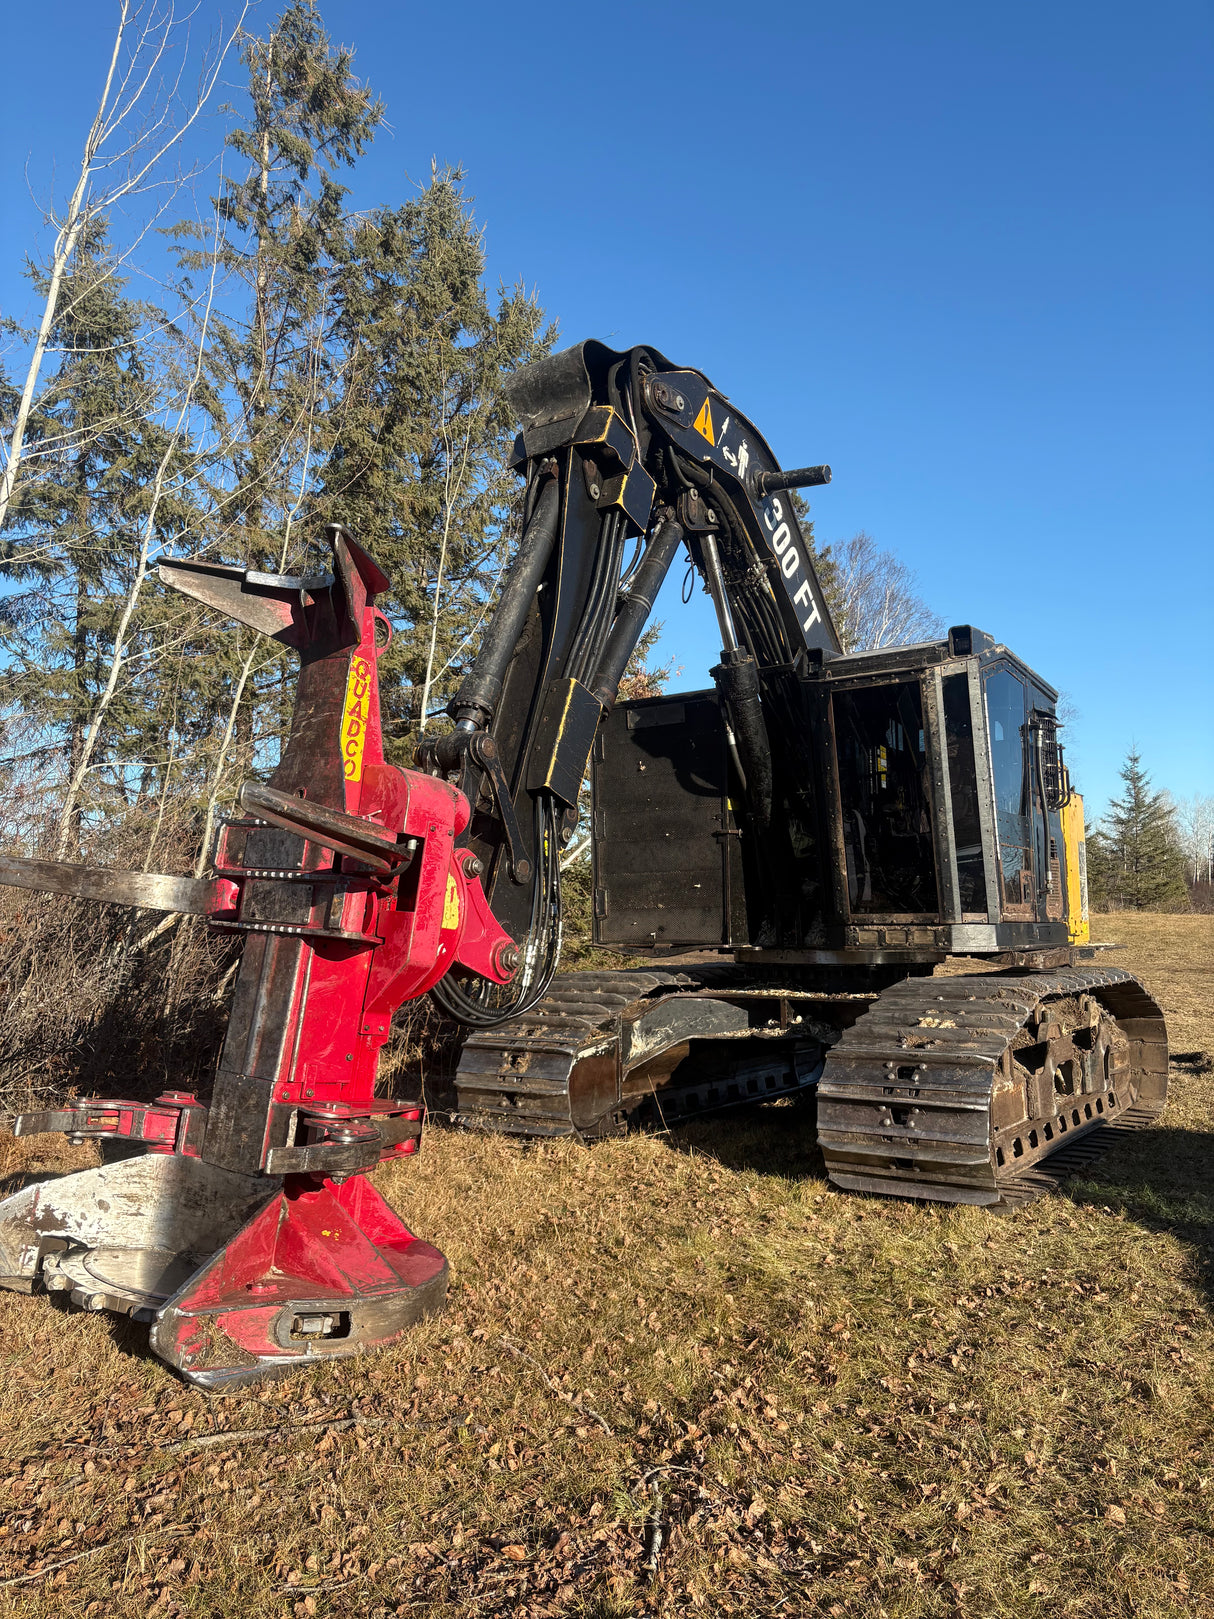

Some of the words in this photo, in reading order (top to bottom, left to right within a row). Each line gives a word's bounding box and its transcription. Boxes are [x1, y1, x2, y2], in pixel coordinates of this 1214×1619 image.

[764, 498, 799, 579] 300
[793, 580, 821, 632] FT
[344, 660, 369, 777] QUADCO
